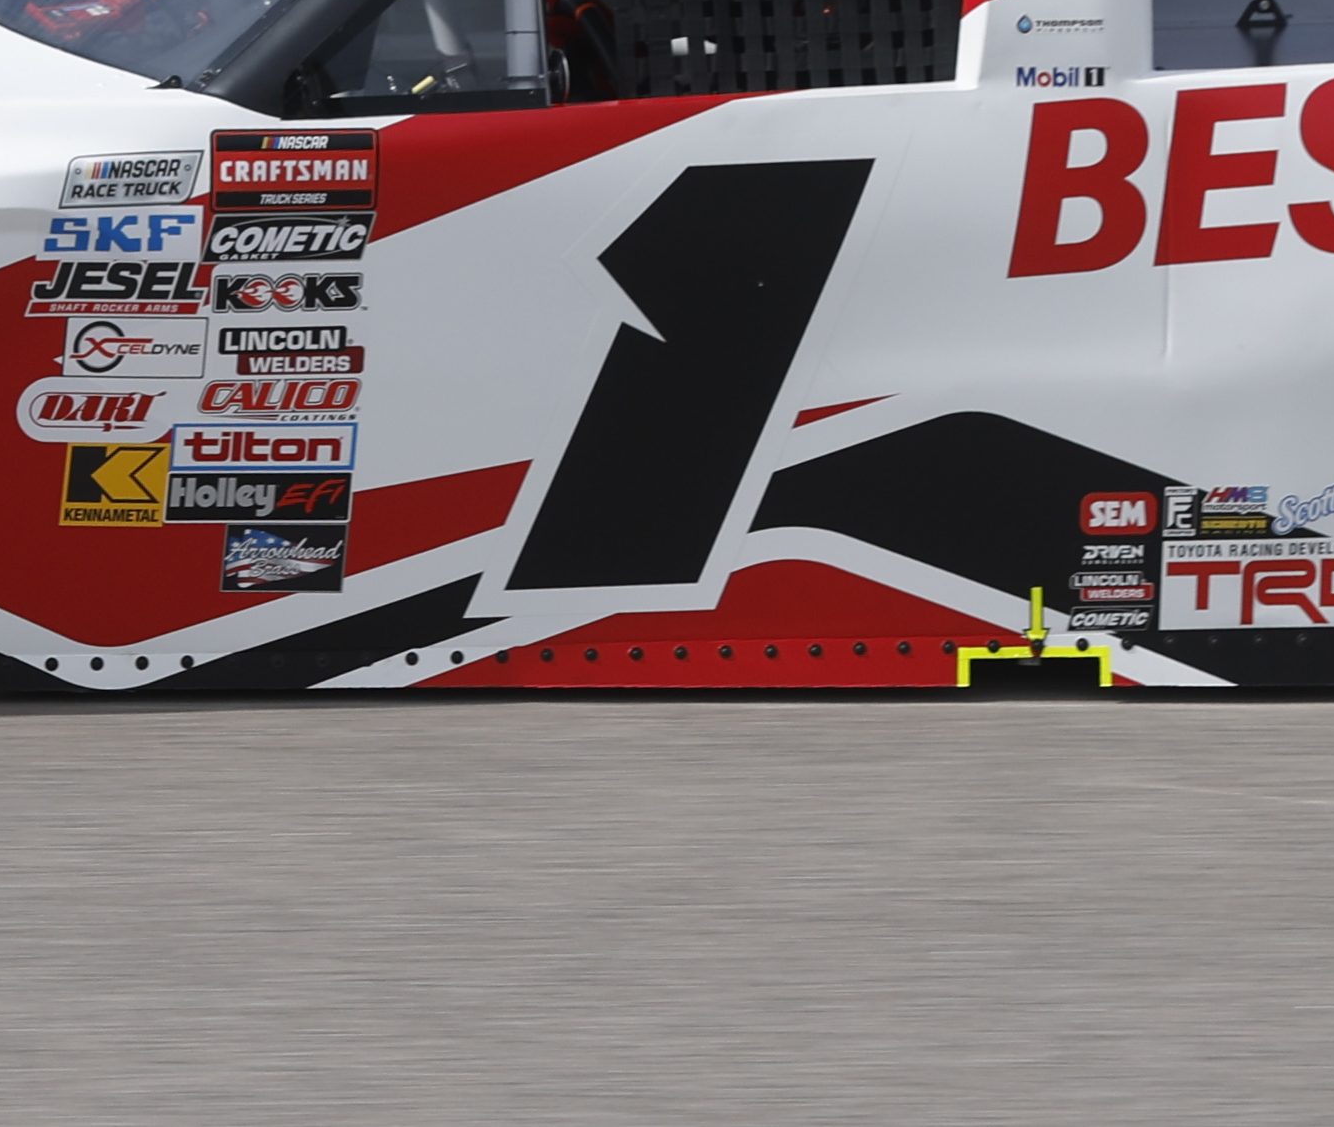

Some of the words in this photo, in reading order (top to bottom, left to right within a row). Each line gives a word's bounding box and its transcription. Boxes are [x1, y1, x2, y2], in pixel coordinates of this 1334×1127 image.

[1016, 67, 1079, 87] Mobil
[1087, 68, 1104, 86] 1
[277, 136, 329, 150] NASCAR
[108, 159, 181, 179] NASCAR
[220, 159, 367, 182] CRAFTSMAN
[70, 184, 118, 199] RACE
[123, 181, 182, 197] TRUCK
[259, 193, 293, 205] TRUCK
[292, 192, 328, 204] SERIES
[44, 215, 195, 252] SKF
[210, 224, 367, 254] COMETIC
[218, 252, 280, 261] GASKET
[33, 262, 205, 300] JESEL
[215, 274, 361, 311] KOOKS
[48, 303, 88, 313] SHAFT
[92, 303, 140, 313] ROCKER
[143, 303, 179, 313] ARMS
[224, 329, 341, 351] LINCOLN
[249, 356, 351, 373] WELDERS
[505, 158, 875, 590] 1
[200, 379, 361, 413] CALICO
[37, 391, 166, 422] DART
[280, 414, 357, 422] COATINGS
[184, 432, 342, 462] tilton
[170, 477, 278, 517] Holley
[63, 507, 159, 523] KENNAMETAL
[1088, 500, 1148, 528] SEM
[224, 537, 344, 560] Arrowhead
[1168, 543, 1220, 559] TOYOTA
[1229, 542, 1283, 558] RACING
[1074, 574, 1139, 587] LINCOLN
[1087, 588, 1145, 599] WELDERS
[1071, 612, 1149, 627] COMETIC
